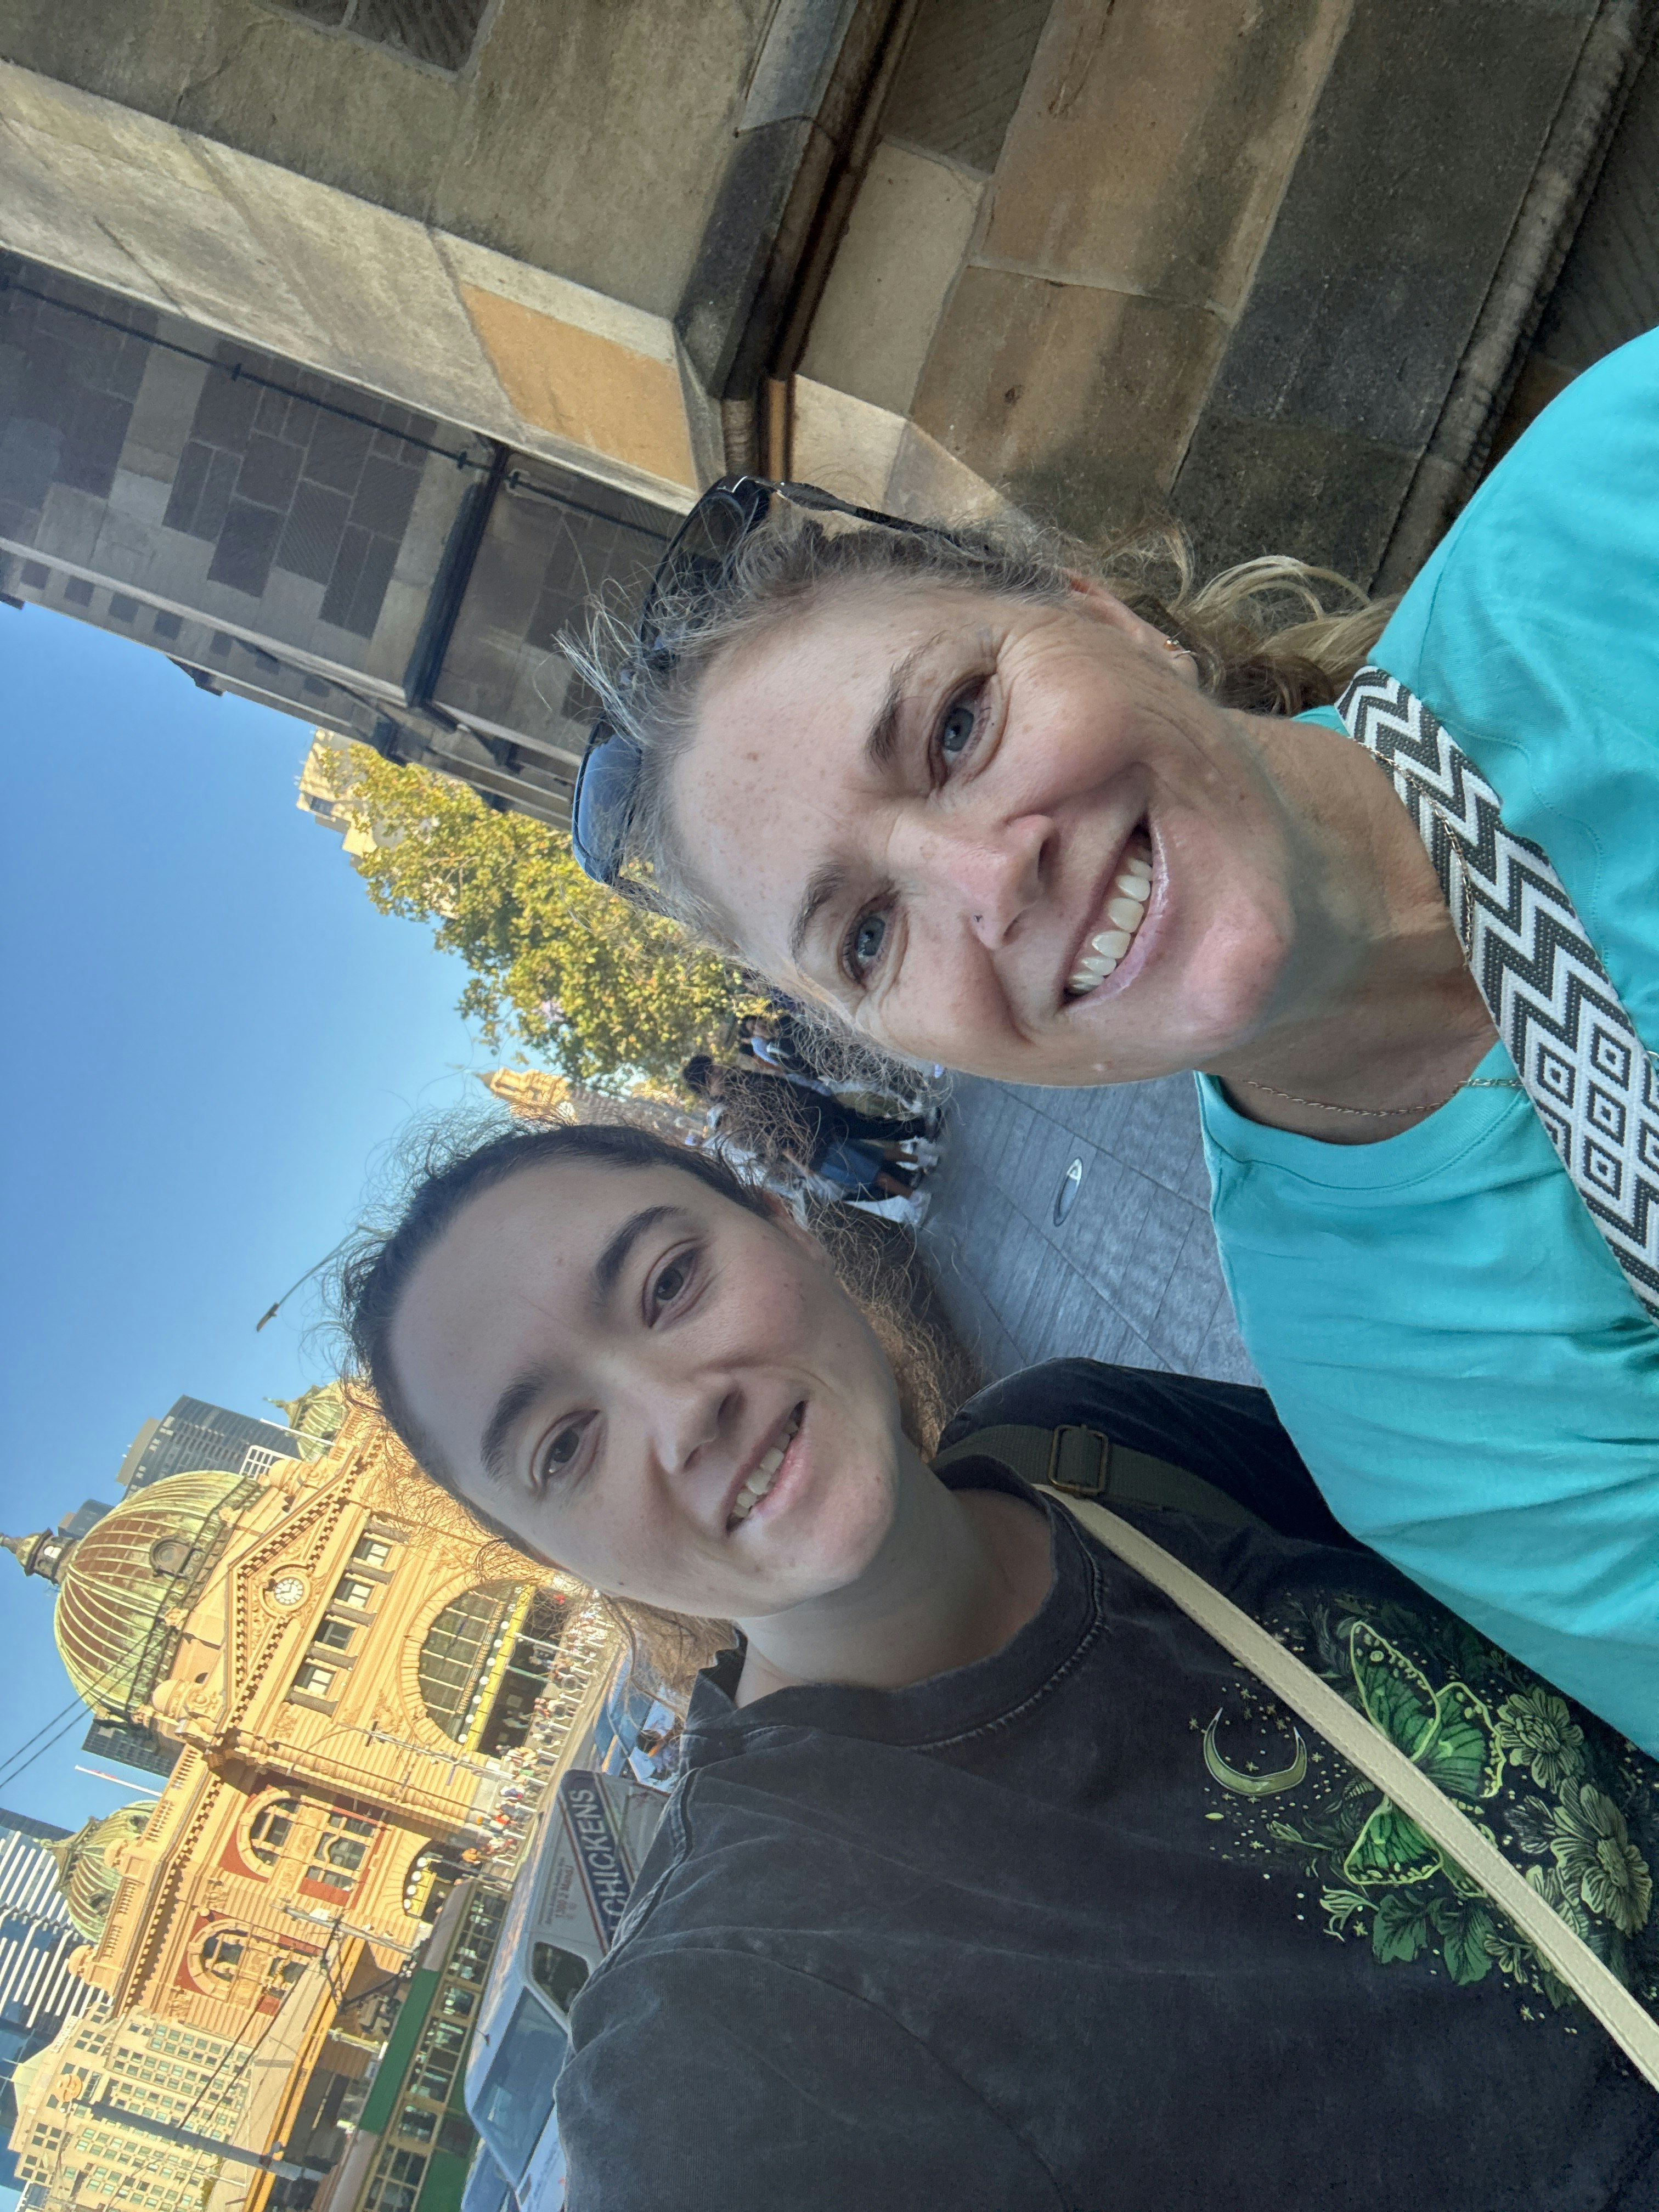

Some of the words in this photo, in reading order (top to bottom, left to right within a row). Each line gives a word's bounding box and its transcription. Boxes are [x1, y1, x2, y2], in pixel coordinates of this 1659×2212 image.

[456, 1678, 477, 1714] FLINDERS
[474, 1641, 490, 1668] STREET
[570, 1789, 627, 1916] CHICKENS
